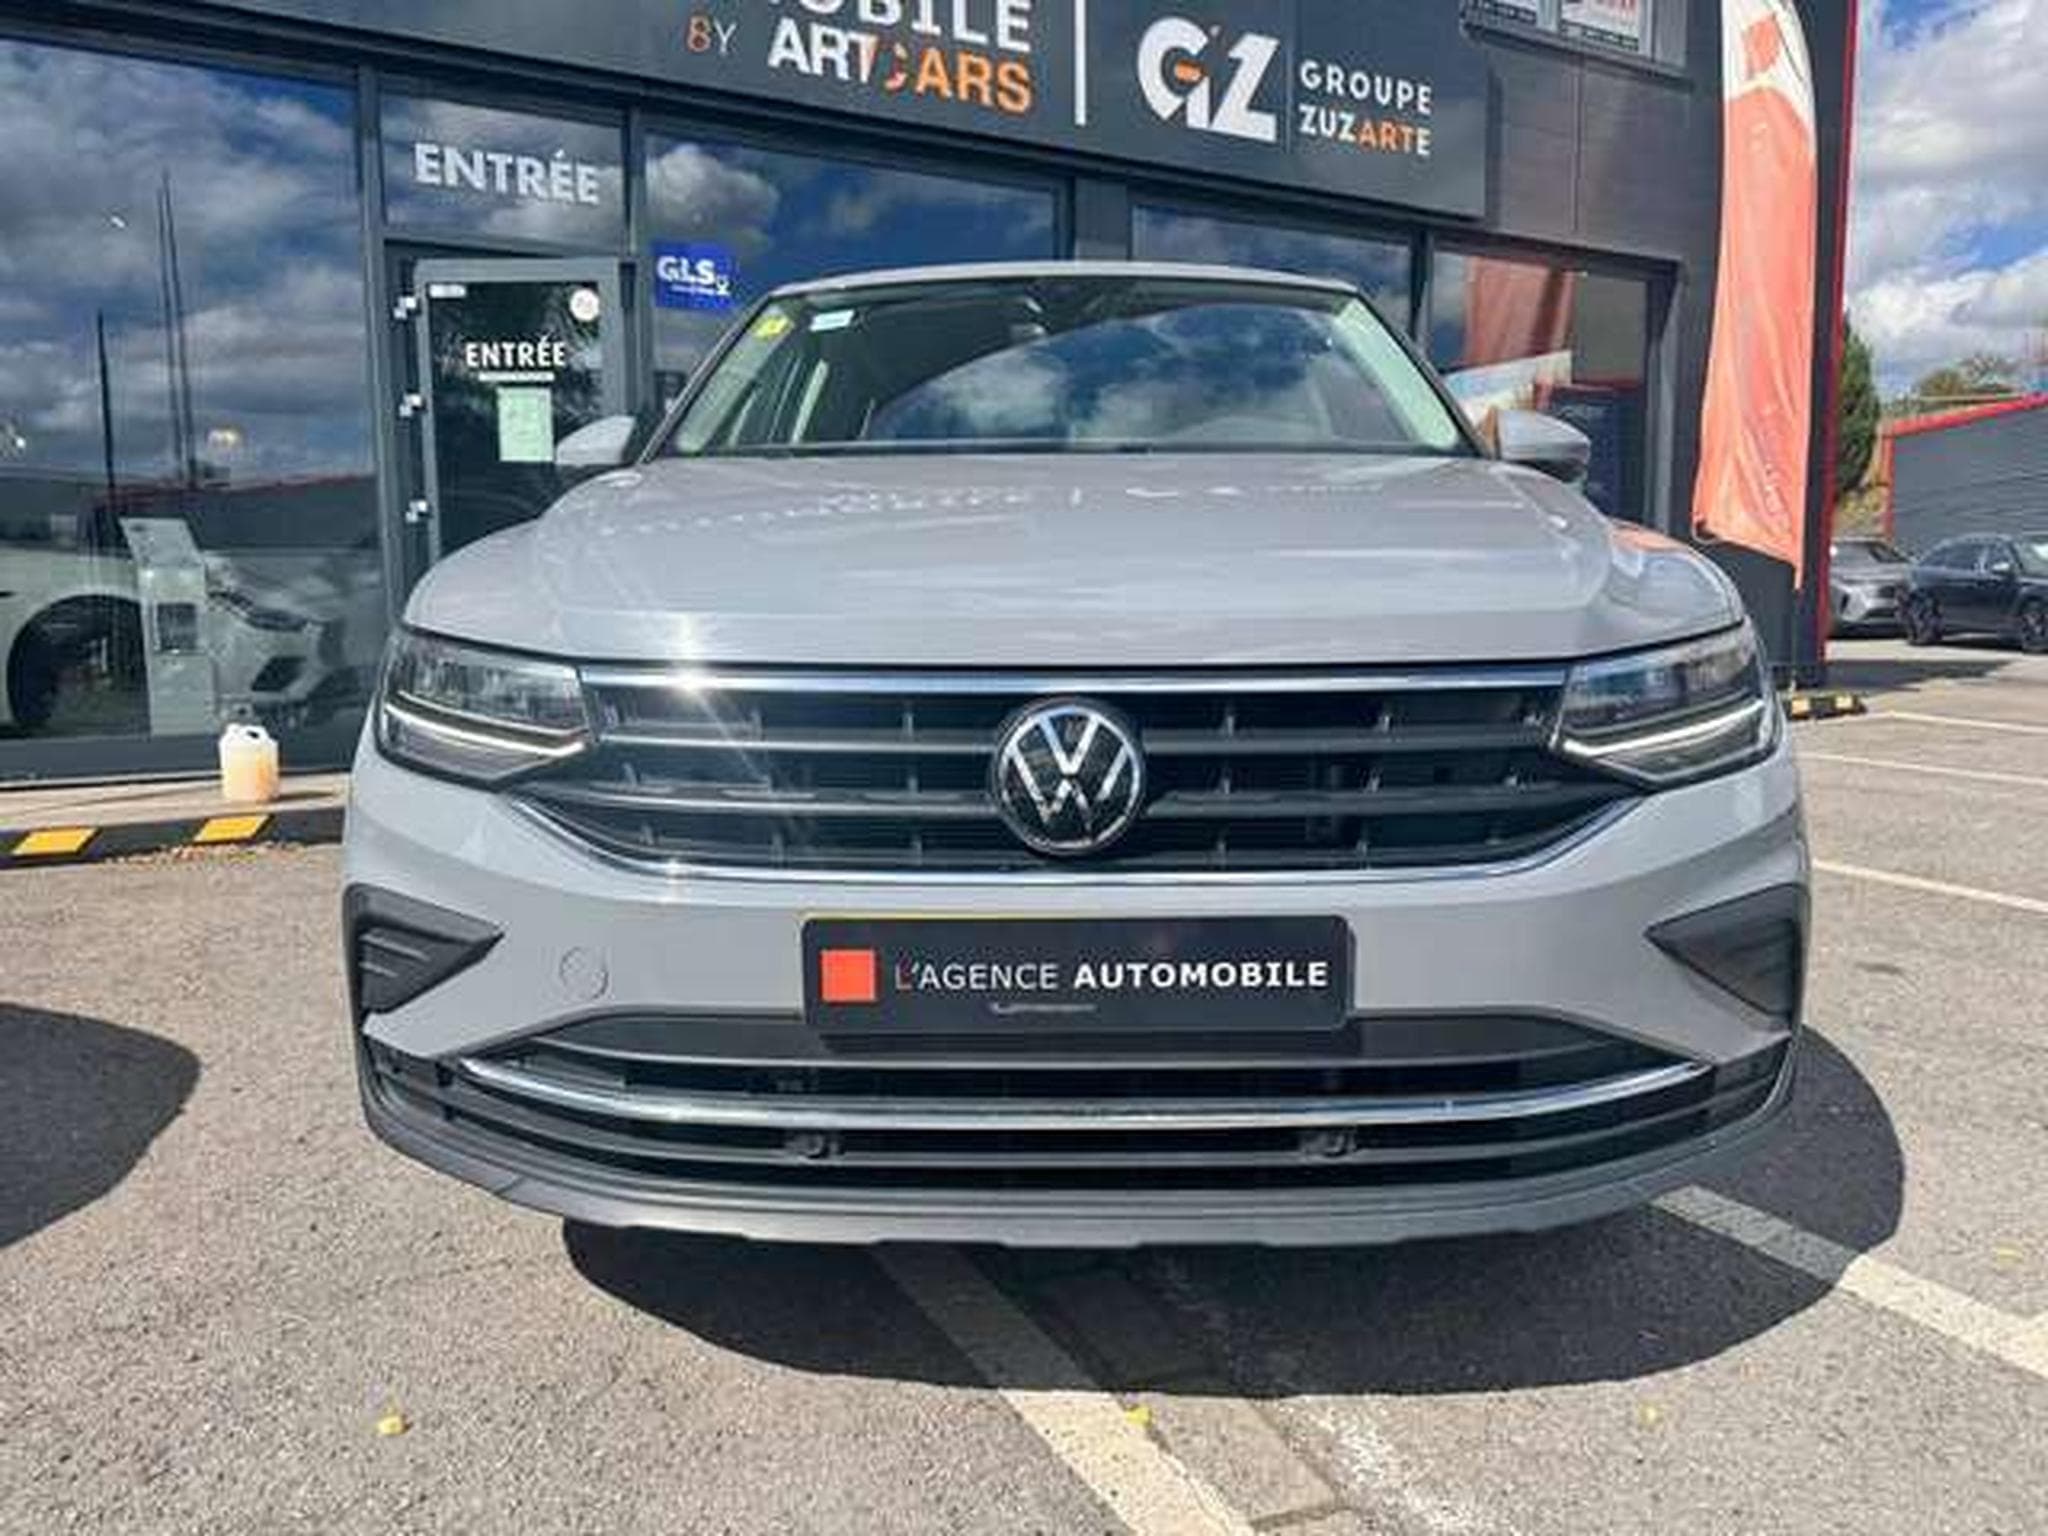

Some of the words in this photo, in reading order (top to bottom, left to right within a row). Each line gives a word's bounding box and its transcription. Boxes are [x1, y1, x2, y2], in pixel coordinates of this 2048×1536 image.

[685, 15, 737, 55] BY
[1300, 60, 1432, 114] GROUPE
[1299, 104, 1432, 156] ZUZARTE
[414, 142, 600, 205] ENTRÉE
[657, 255, 716, 286] GLS
[465, 335, 567, 368] ENTRÉE
[894, 961, 1060, 991] L'AGENCE
[1072, 960, 1330, 991] AUTOMOBILE
